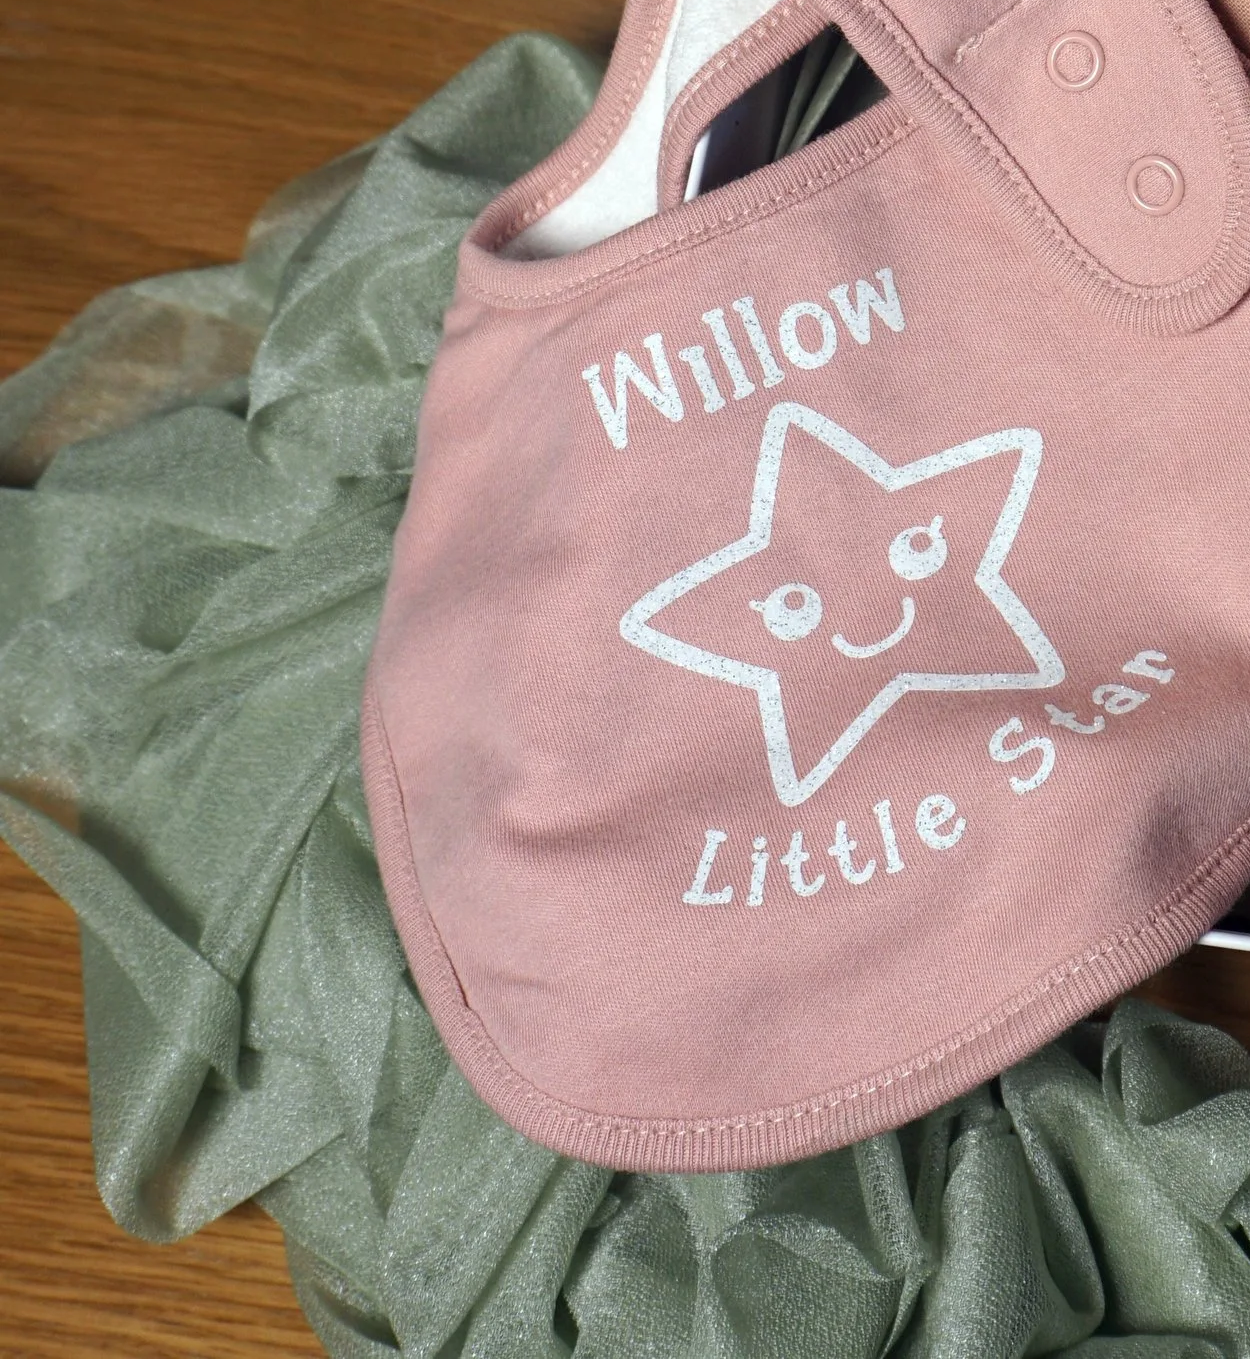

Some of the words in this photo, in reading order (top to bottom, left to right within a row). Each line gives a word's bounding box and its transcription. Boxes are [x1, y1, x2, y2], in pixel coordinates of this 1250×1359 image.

[581, 267, 906, 450] Willow
[681, 793, 967, 906] Little
[987, 649, 1176, 795] Star
